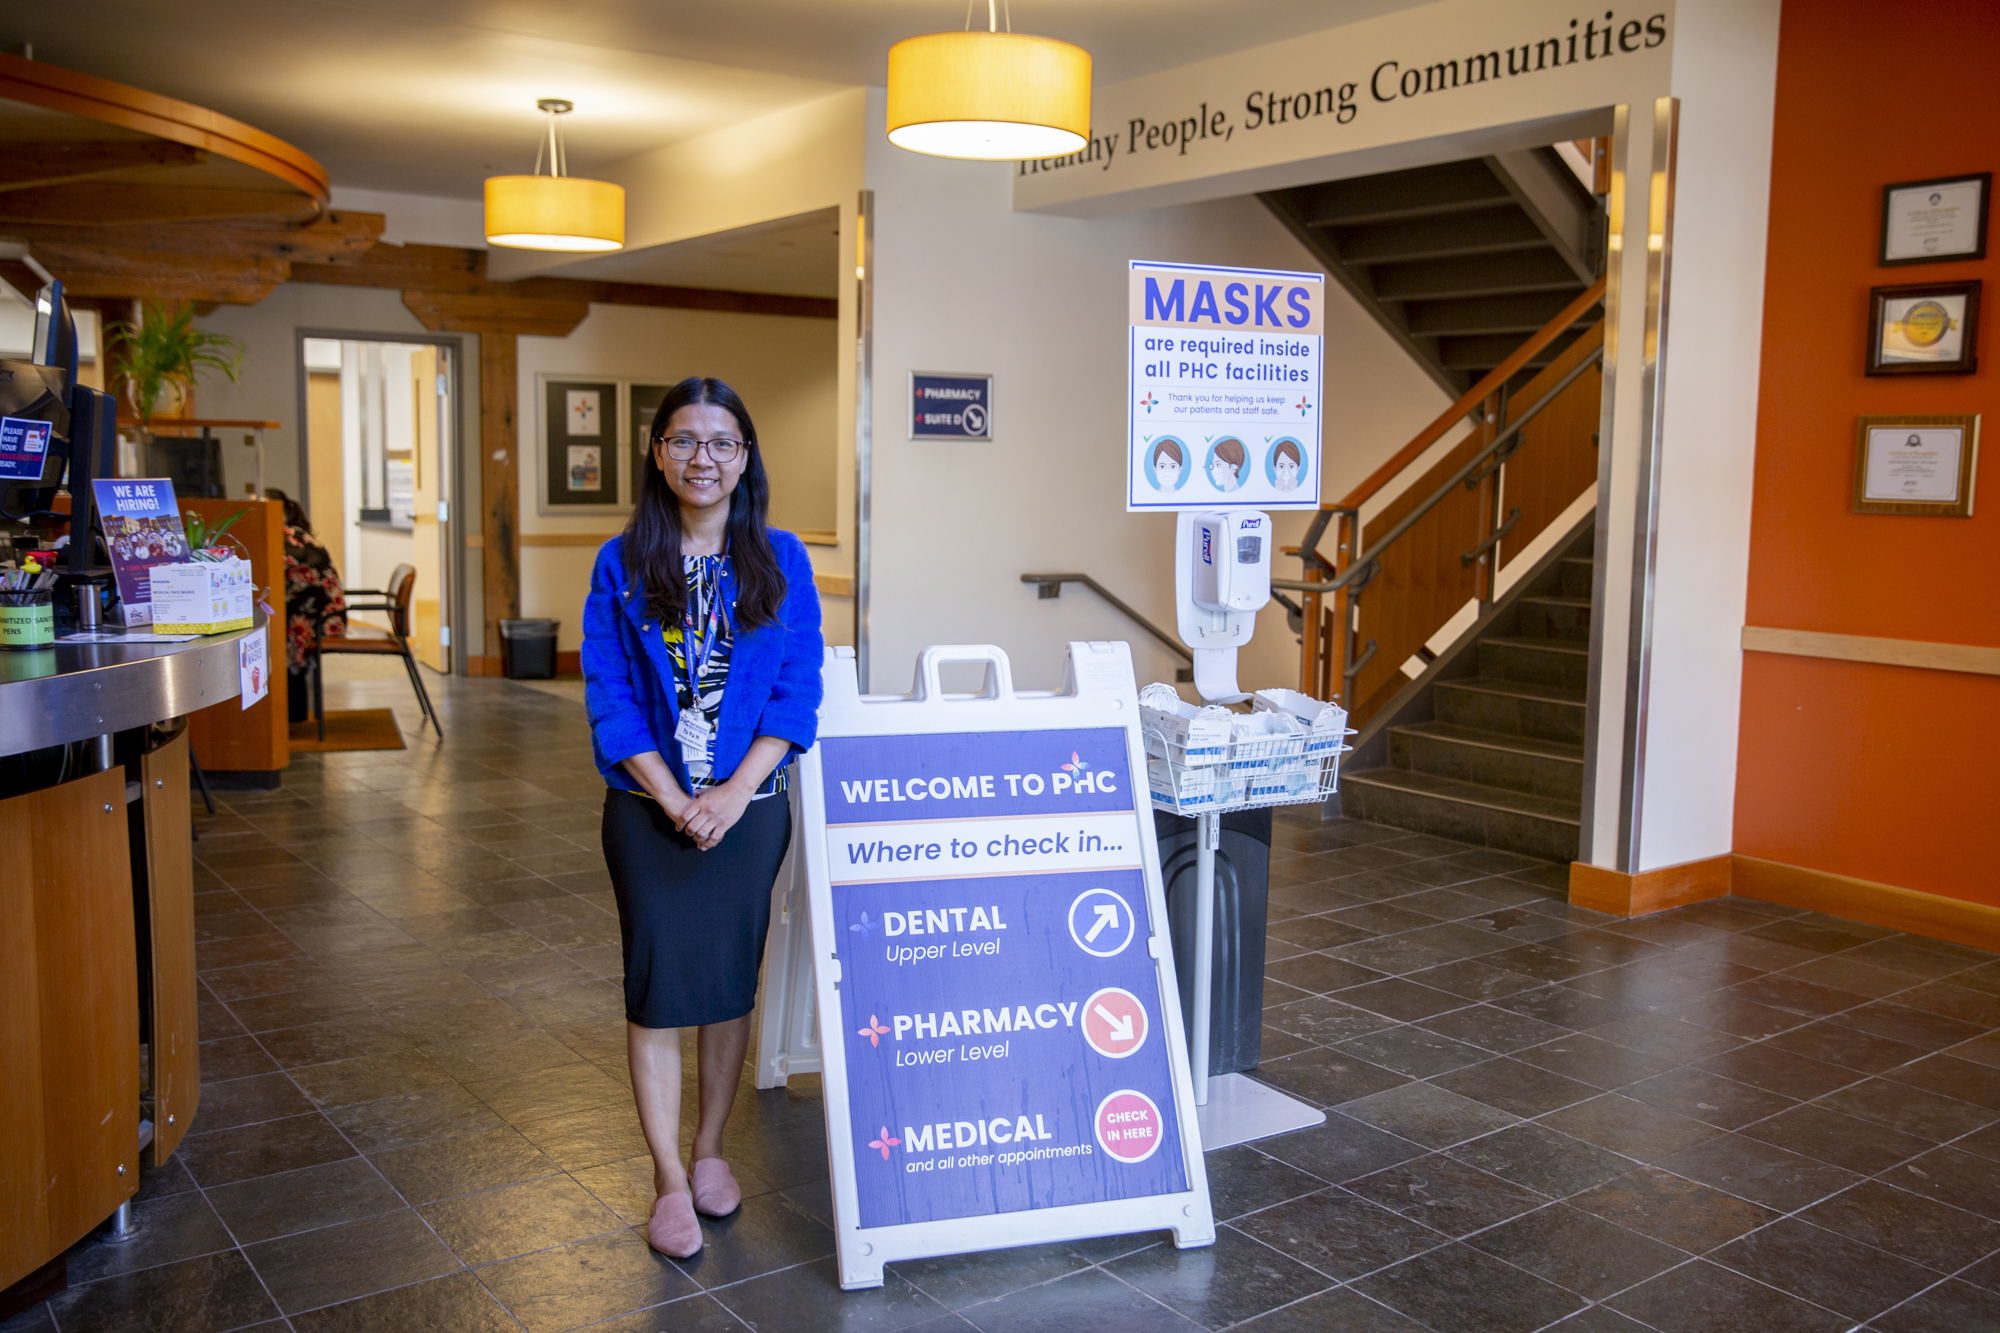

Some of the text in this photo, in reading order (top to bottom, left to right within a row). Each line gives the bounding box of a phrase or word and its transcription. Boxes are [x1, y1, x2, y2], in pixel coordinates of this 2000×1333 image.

[1126, 101, 1235, 157] People,
[1244, 82, 1359, 125] Strong
[1370, 10, 1667, 104] Communities
[1144, 276, 1311, 329] MASKS
[1144, 337, 1310, 358] are required inside
[1145, 360, 1309, 382] all PHC facilities
[924, 387, 982, 401] PHARMACY
[1168, 393, 1286, 406] Thank you for helping us keep
[1173, 405, 1280, 415] our patients and staff safe.
[924, 413, 962, 426] SUITE D
[3, 426, 24, 436] PLEASE
[1, 443, 18, 452] YOUR
[2, 435, 19, 444] HAVE
[112, 484, 157, 498] WE ARE
[115, 498, 161, 512] HIRING!
[0, 617, 32, 625] ANITIZED
[2, 627, 22, 635] PENS
[840, 770, 1118, 804] WELCOME TO PHC
[847, 829, 1123, 865] Where to check in...
[883, 905, 1007, 936] DENTAL
[886, 937, 1001, 966] Upper Level
[893, 1001, 1078, 1041] PHARMACY
[896, 1040, 1009, 1067] Lower Level
[1106, 1109, 1149, 1124] CHECK
[904, 1113, 1052, 1153] MEDICAL
[1106, 1126, 1153, 1142] IN HERE
[906, 1143, 1093, 1173] and all other appointments
